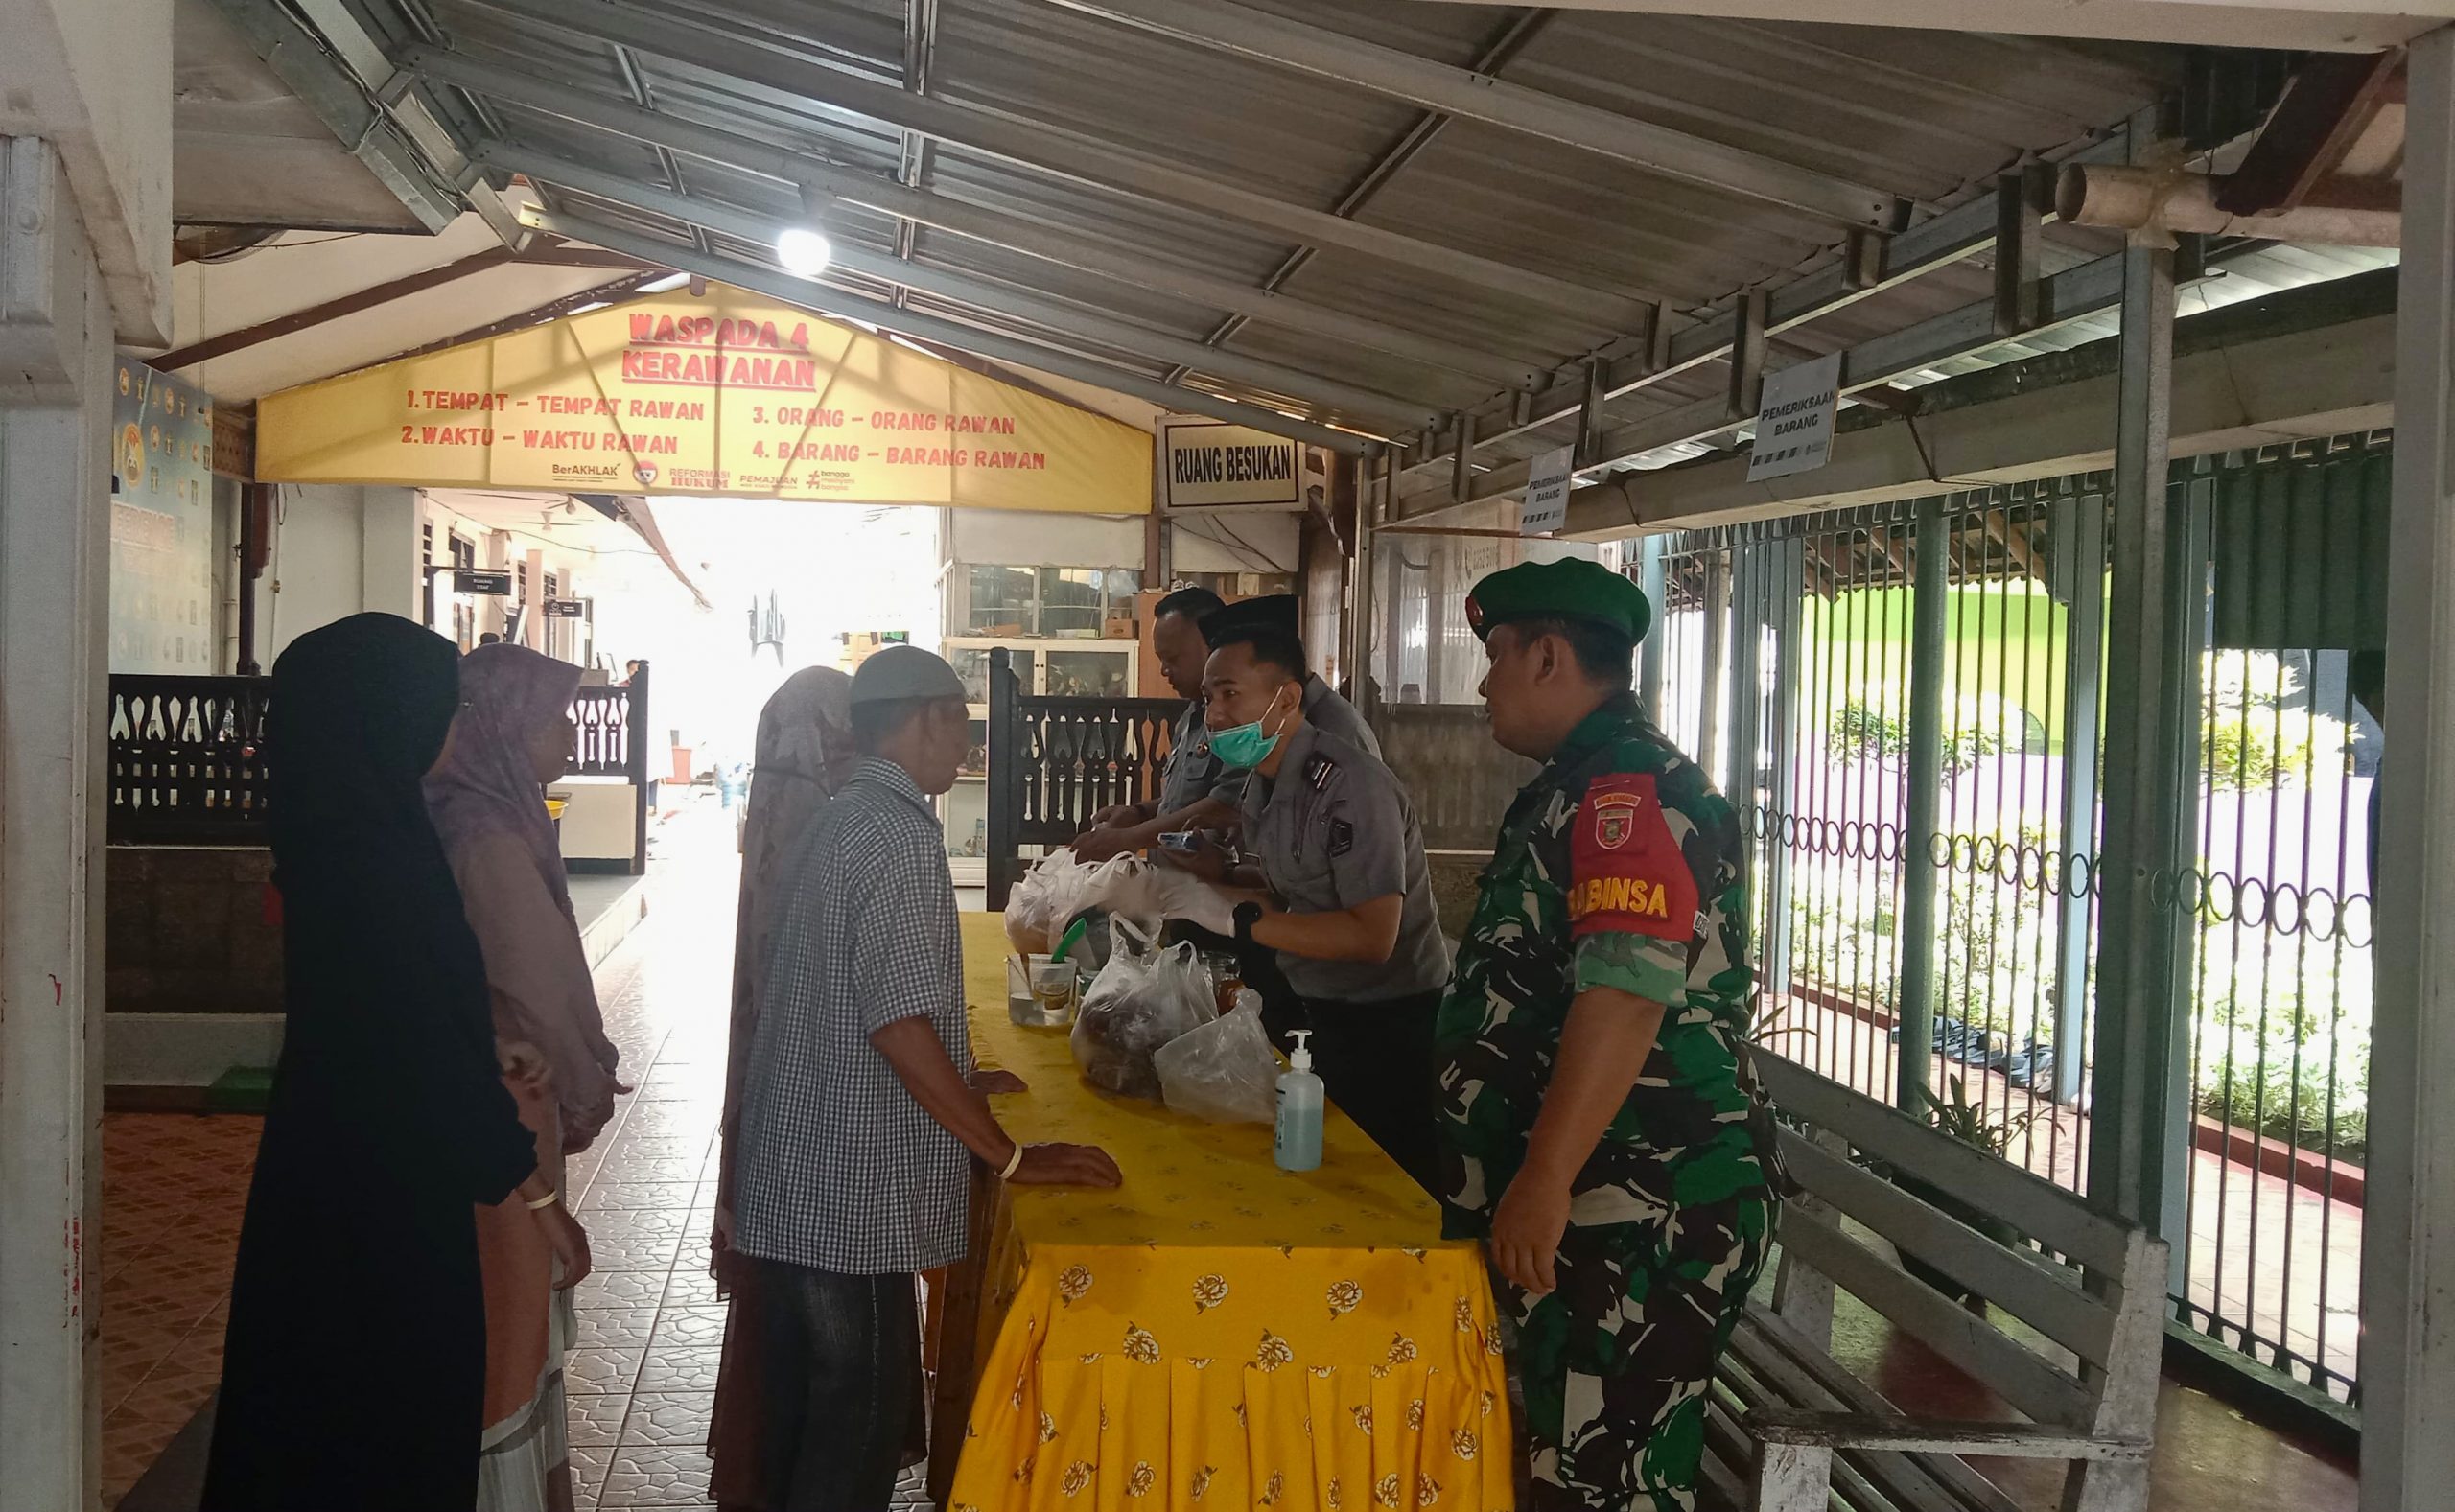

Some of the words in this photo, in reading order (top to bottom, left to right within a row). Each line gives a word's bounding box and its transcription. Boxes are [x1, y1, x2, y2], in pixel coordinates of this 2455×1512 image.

[629, 313, 779, 348] WASPADA
[790, 322, 810, 349] 4
[622, 349, 815, 386] KERAWANAN
[536, 395, 621, 416] TEMPAT
[629, 399, 705, 421] RAWAN
[777, 407, 844, 428] ORANG
[871, 411, 937, 431] ORANG
[944, 413, 1016, 435] RAWAN
[1774, 413, 1818, 436] BARANG
[523, 430, 596, 451] WAKTU
[602, 432, 678, 454] RAWAN
[777, 441, 860, 463] BARANG
[886, 446, 968, 467] BARANG
[974, 449, 1045, 470] RAWAN
[552, 462, 620, 476] BerAKHLAK
[669, 467, 731, 479] REFORMASI
[1175, 447, 1222, 483] RUANG
[1227, 445, 1291, 481] BESUKAN
